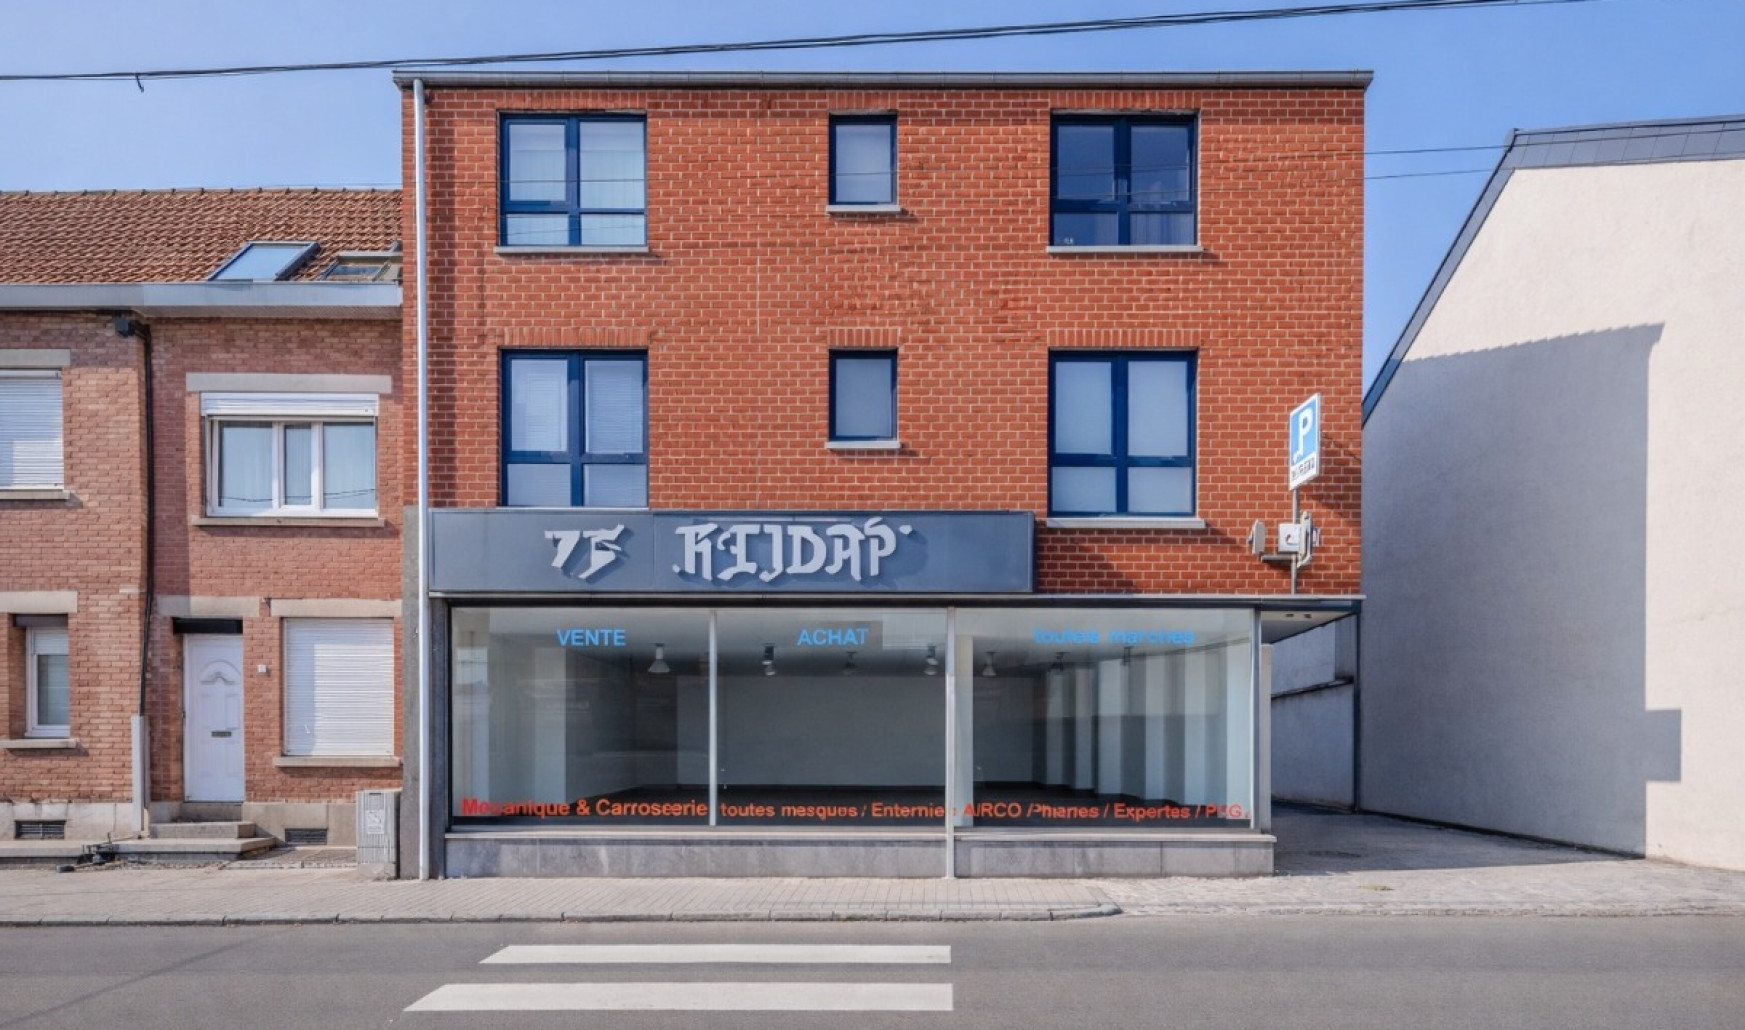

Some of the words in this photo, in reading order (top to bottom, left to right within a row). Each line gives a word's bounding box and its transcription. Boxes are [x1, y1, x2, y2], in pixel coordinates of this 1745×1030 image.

[1298, 407, 1314, 457] P
[556, 628, 627, 647] VENTE
[796, 628, 870, 646] ACHAT
[576, 797, 591, 816] &
[720, 802, 776, 817] toutes
[963, 802, 1022, 818] AIRCO
